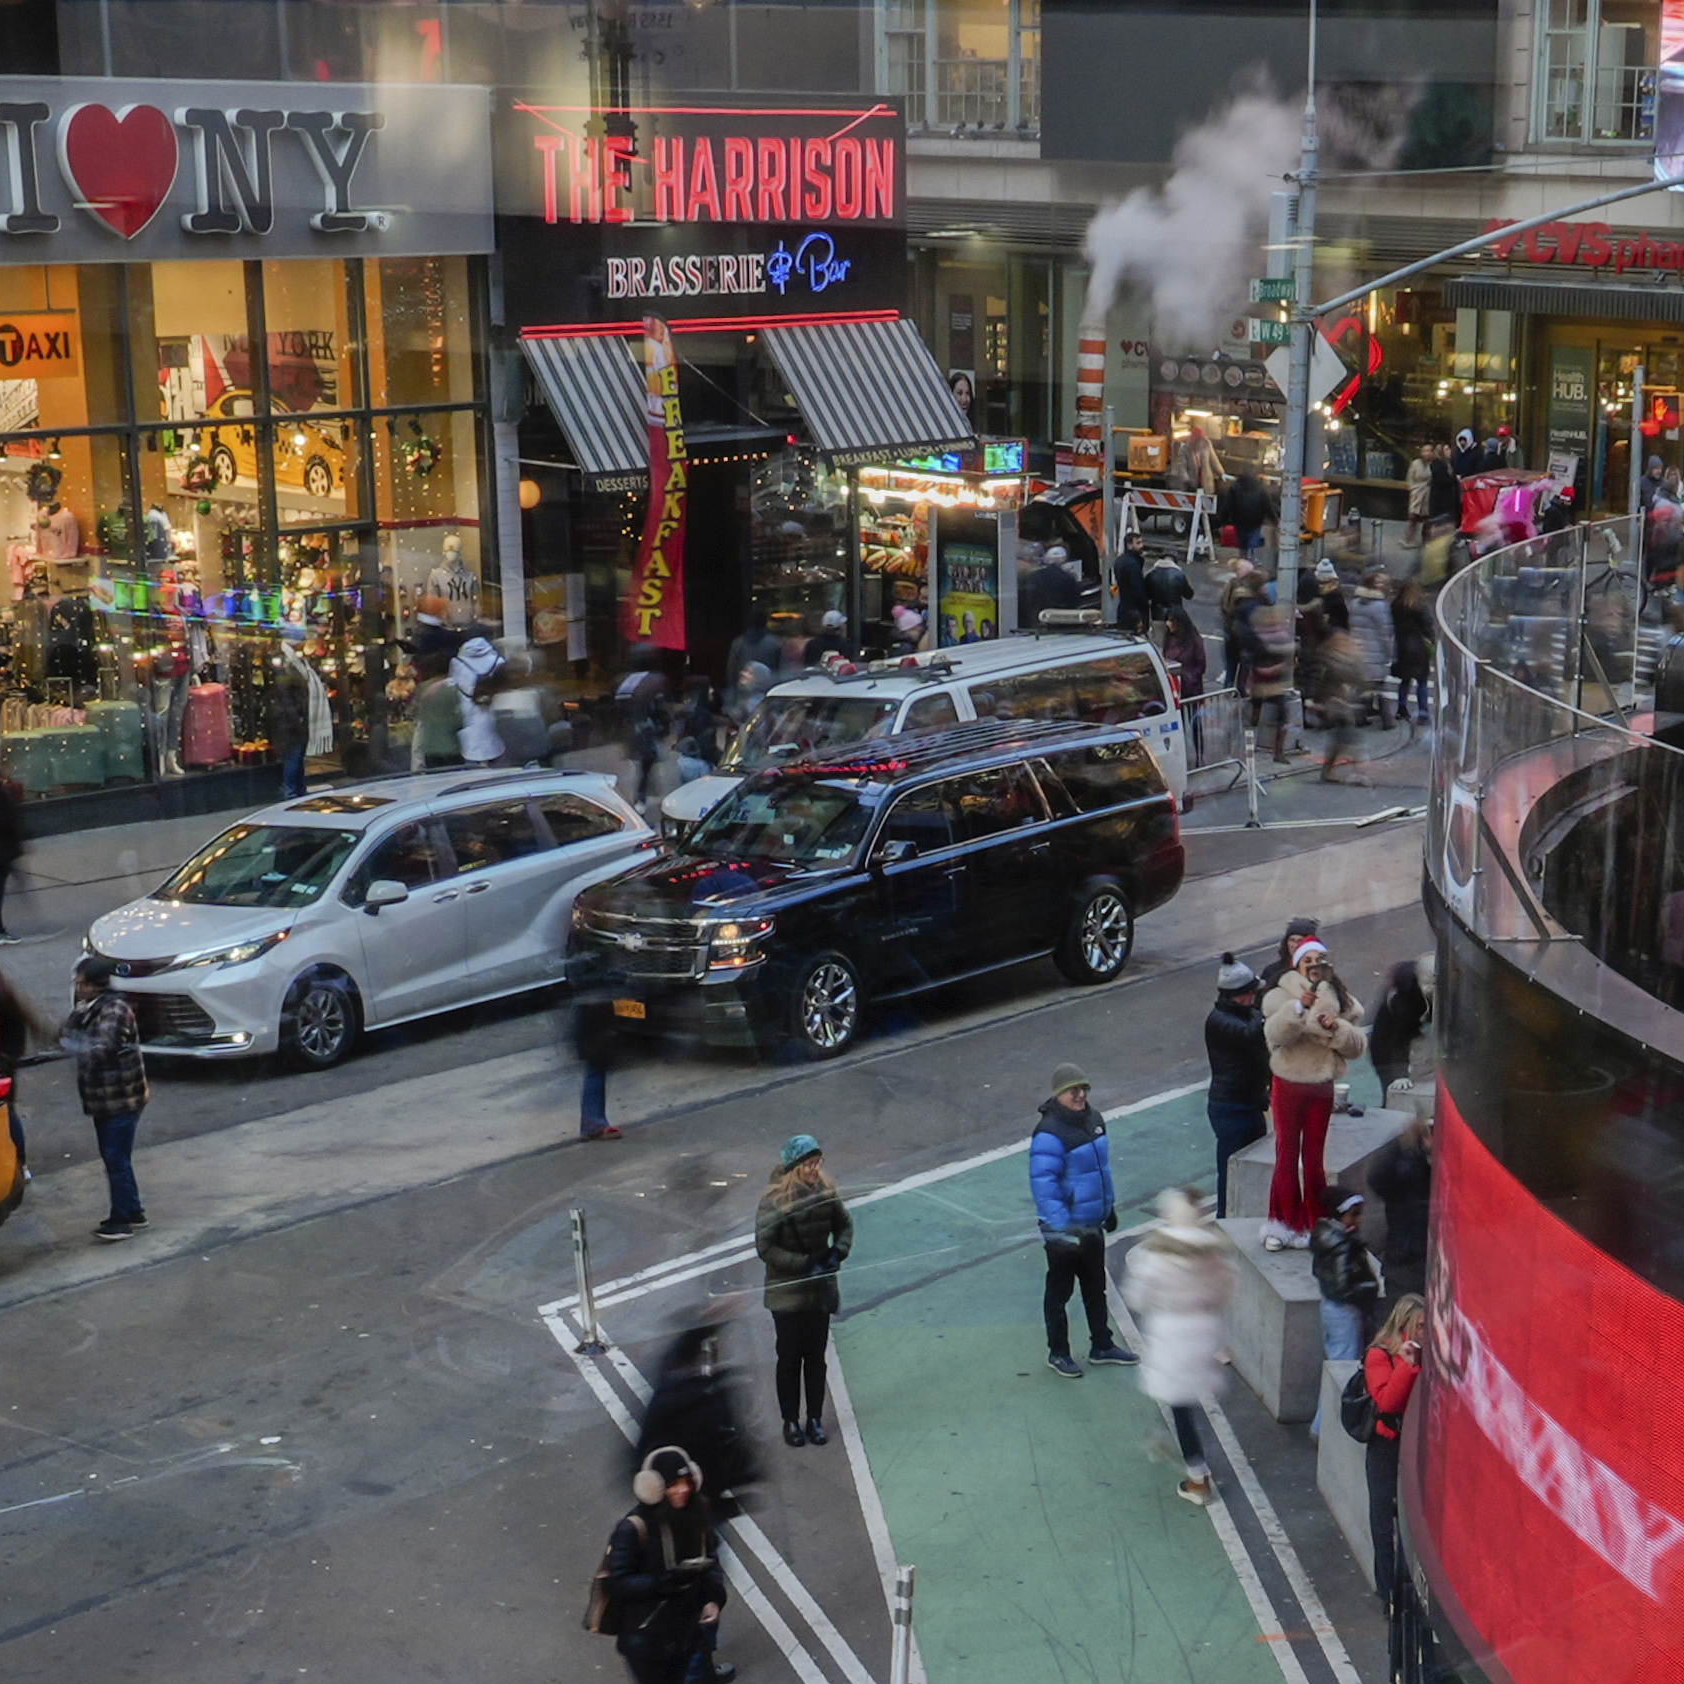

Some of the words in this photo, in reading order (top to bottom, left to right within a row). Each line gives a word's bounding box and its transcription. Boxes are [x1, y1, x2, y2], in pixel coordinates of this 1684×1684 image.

[174, 105, 385, 236] NY
[533, 134, 635, 225] THE
[653, 134, 895, 223] HARRISON
[606, 253, 766, 298] BRASSERIE
[795, 231, 852, 293] Bar
[1524, 221, 1613, 266] CVS
[277, 331, 337, 361] YORK
[1261, 322, 1272, 337] W
[1274, 322, 1283, 342] 49
[831, 449, 893, 467] BREAKFAST
[899, 445, 936, 458] LUNCH
[940, 440, 976, 452] DINNER
[595, 475, 649, 493] DESSERTS
[634, 364, 688, 637] BREAKFAST
